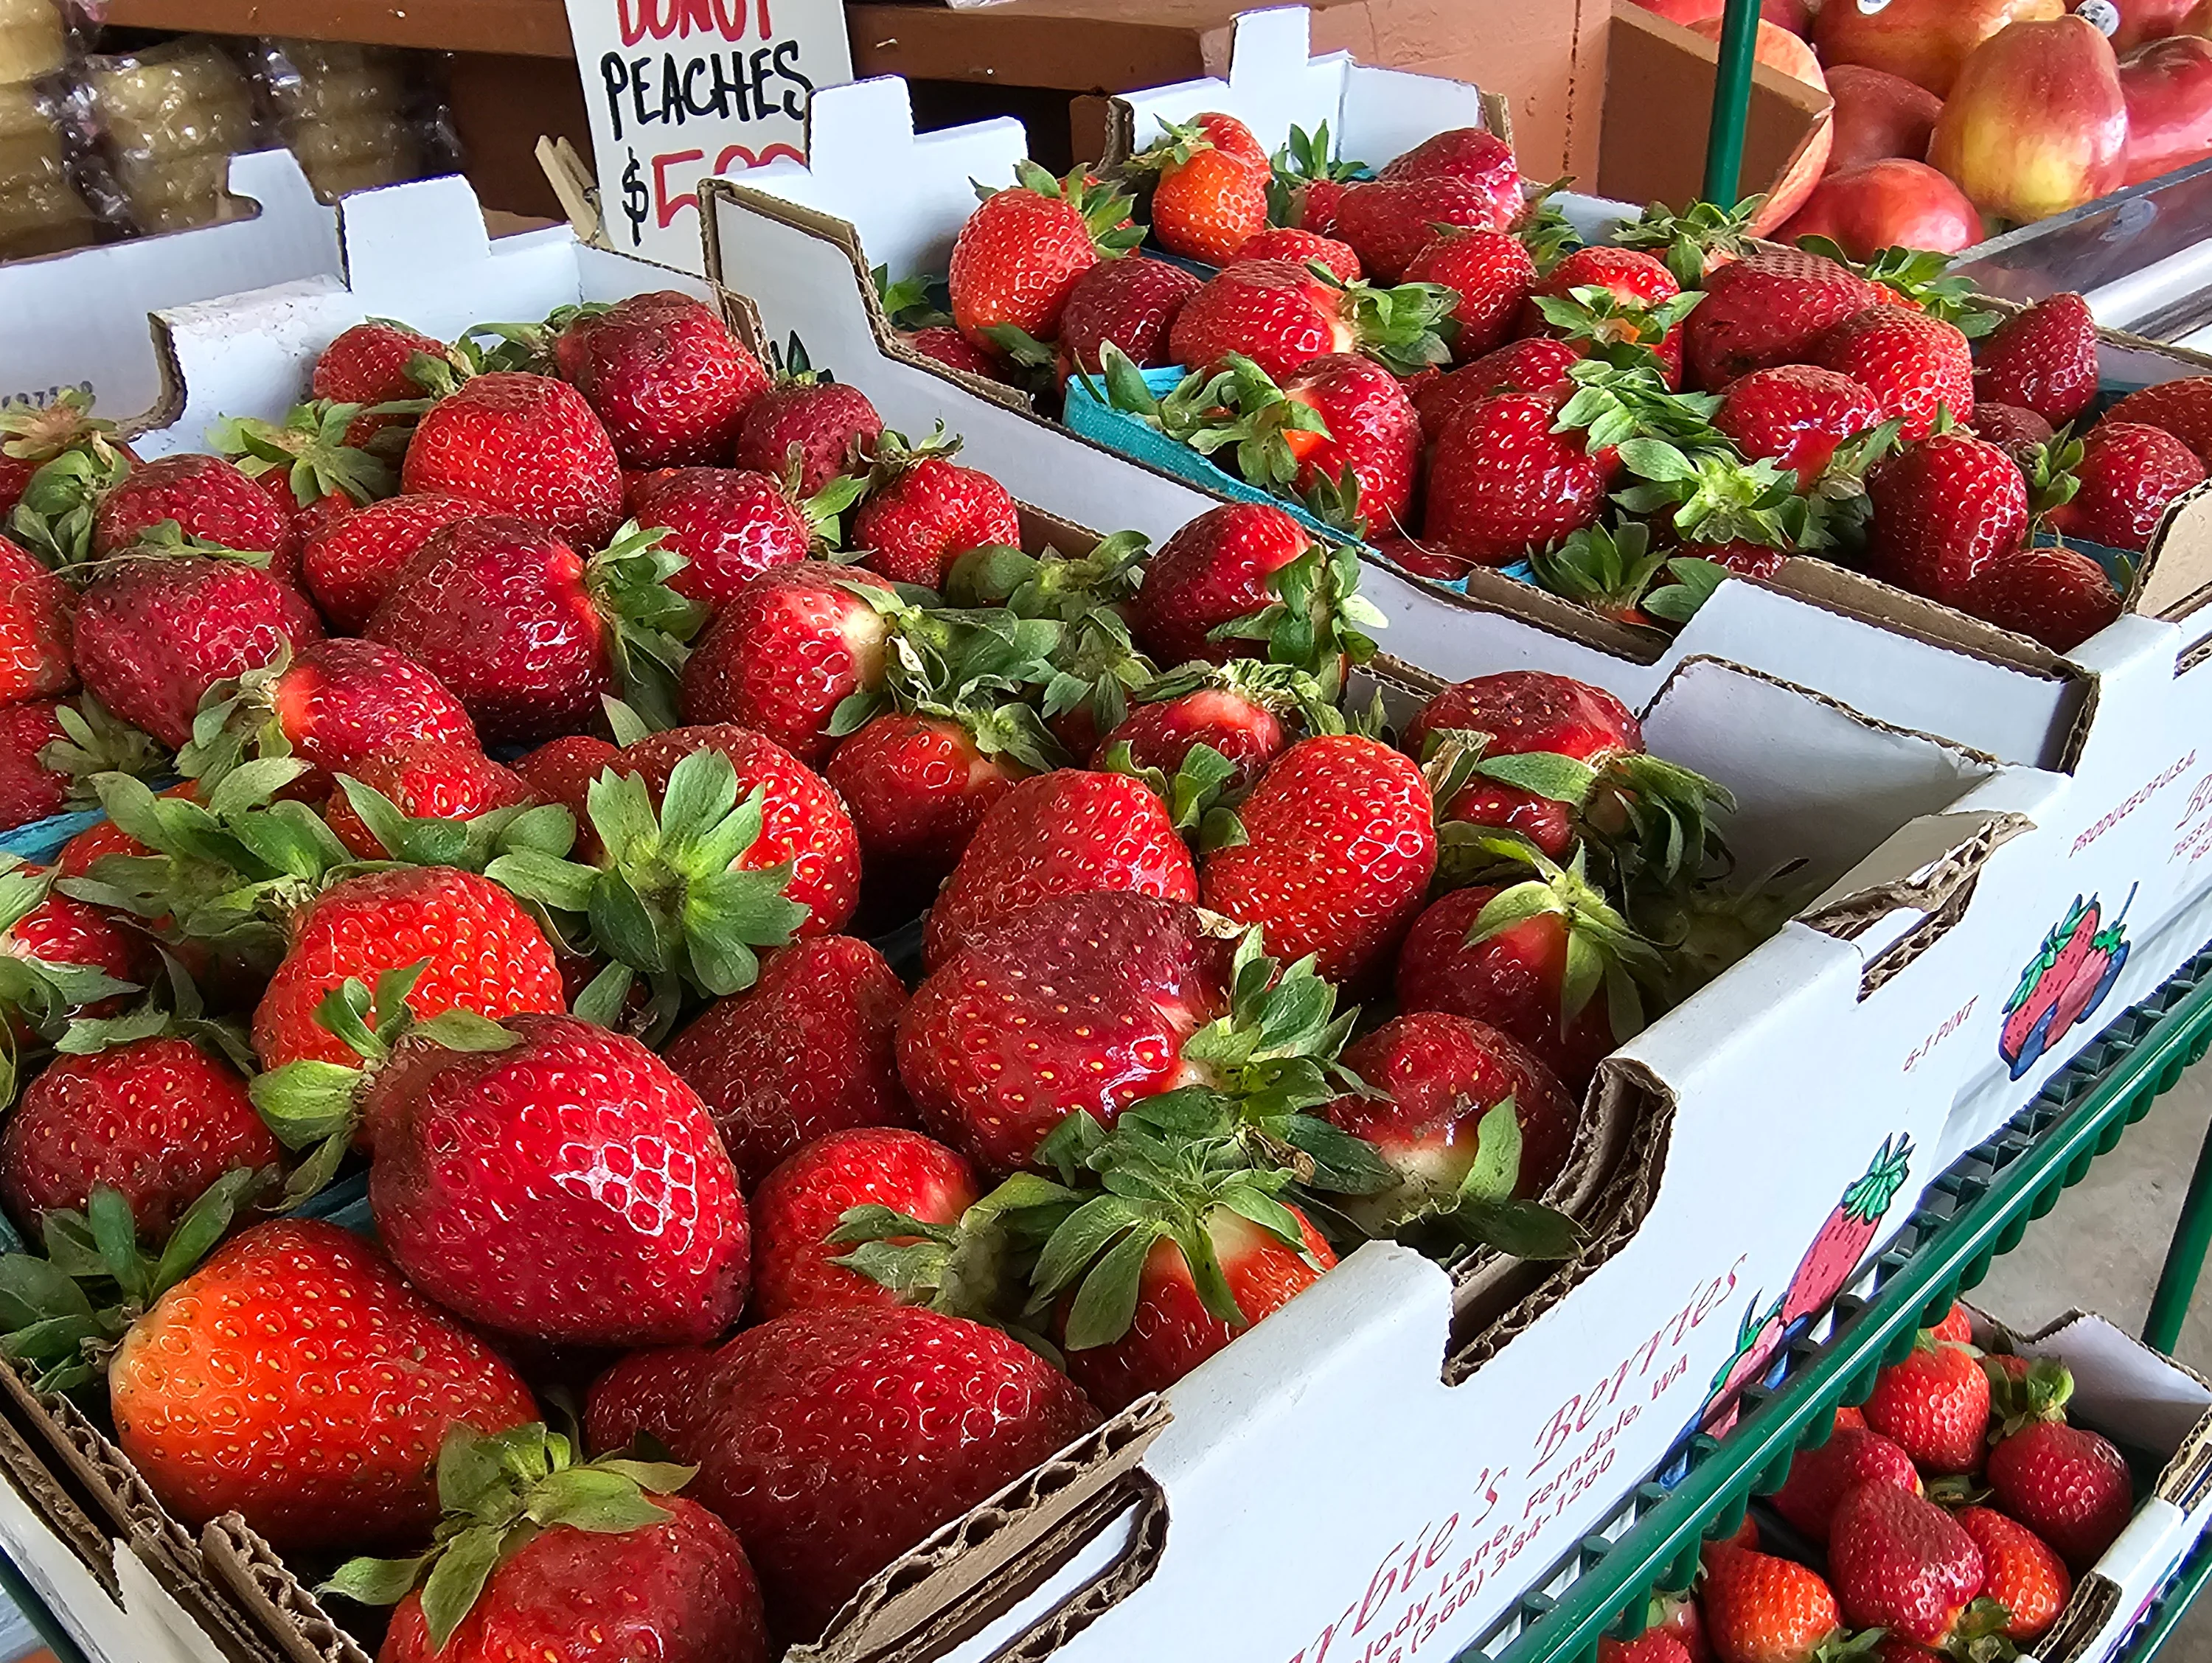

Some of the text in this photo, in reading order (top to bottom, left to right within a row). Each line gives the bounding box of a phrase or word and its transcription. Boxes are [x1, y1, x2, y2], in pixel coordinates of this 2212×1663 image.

[601, 41, 816, 141] PEACHES
[1933, 994, 1979, 1047] PINT
[1526, 1252, 1748, 1479] Berries
[1411, 1568, 1484, 1654] (360)
[1490, 1447, 1615, 1577] 384-1260
[1439, 1524, 1515, 1598] Lane,
[1523, 1404, 1643, 1521] Ferndale,
[1652, 1353, 1687, 1401] WA
